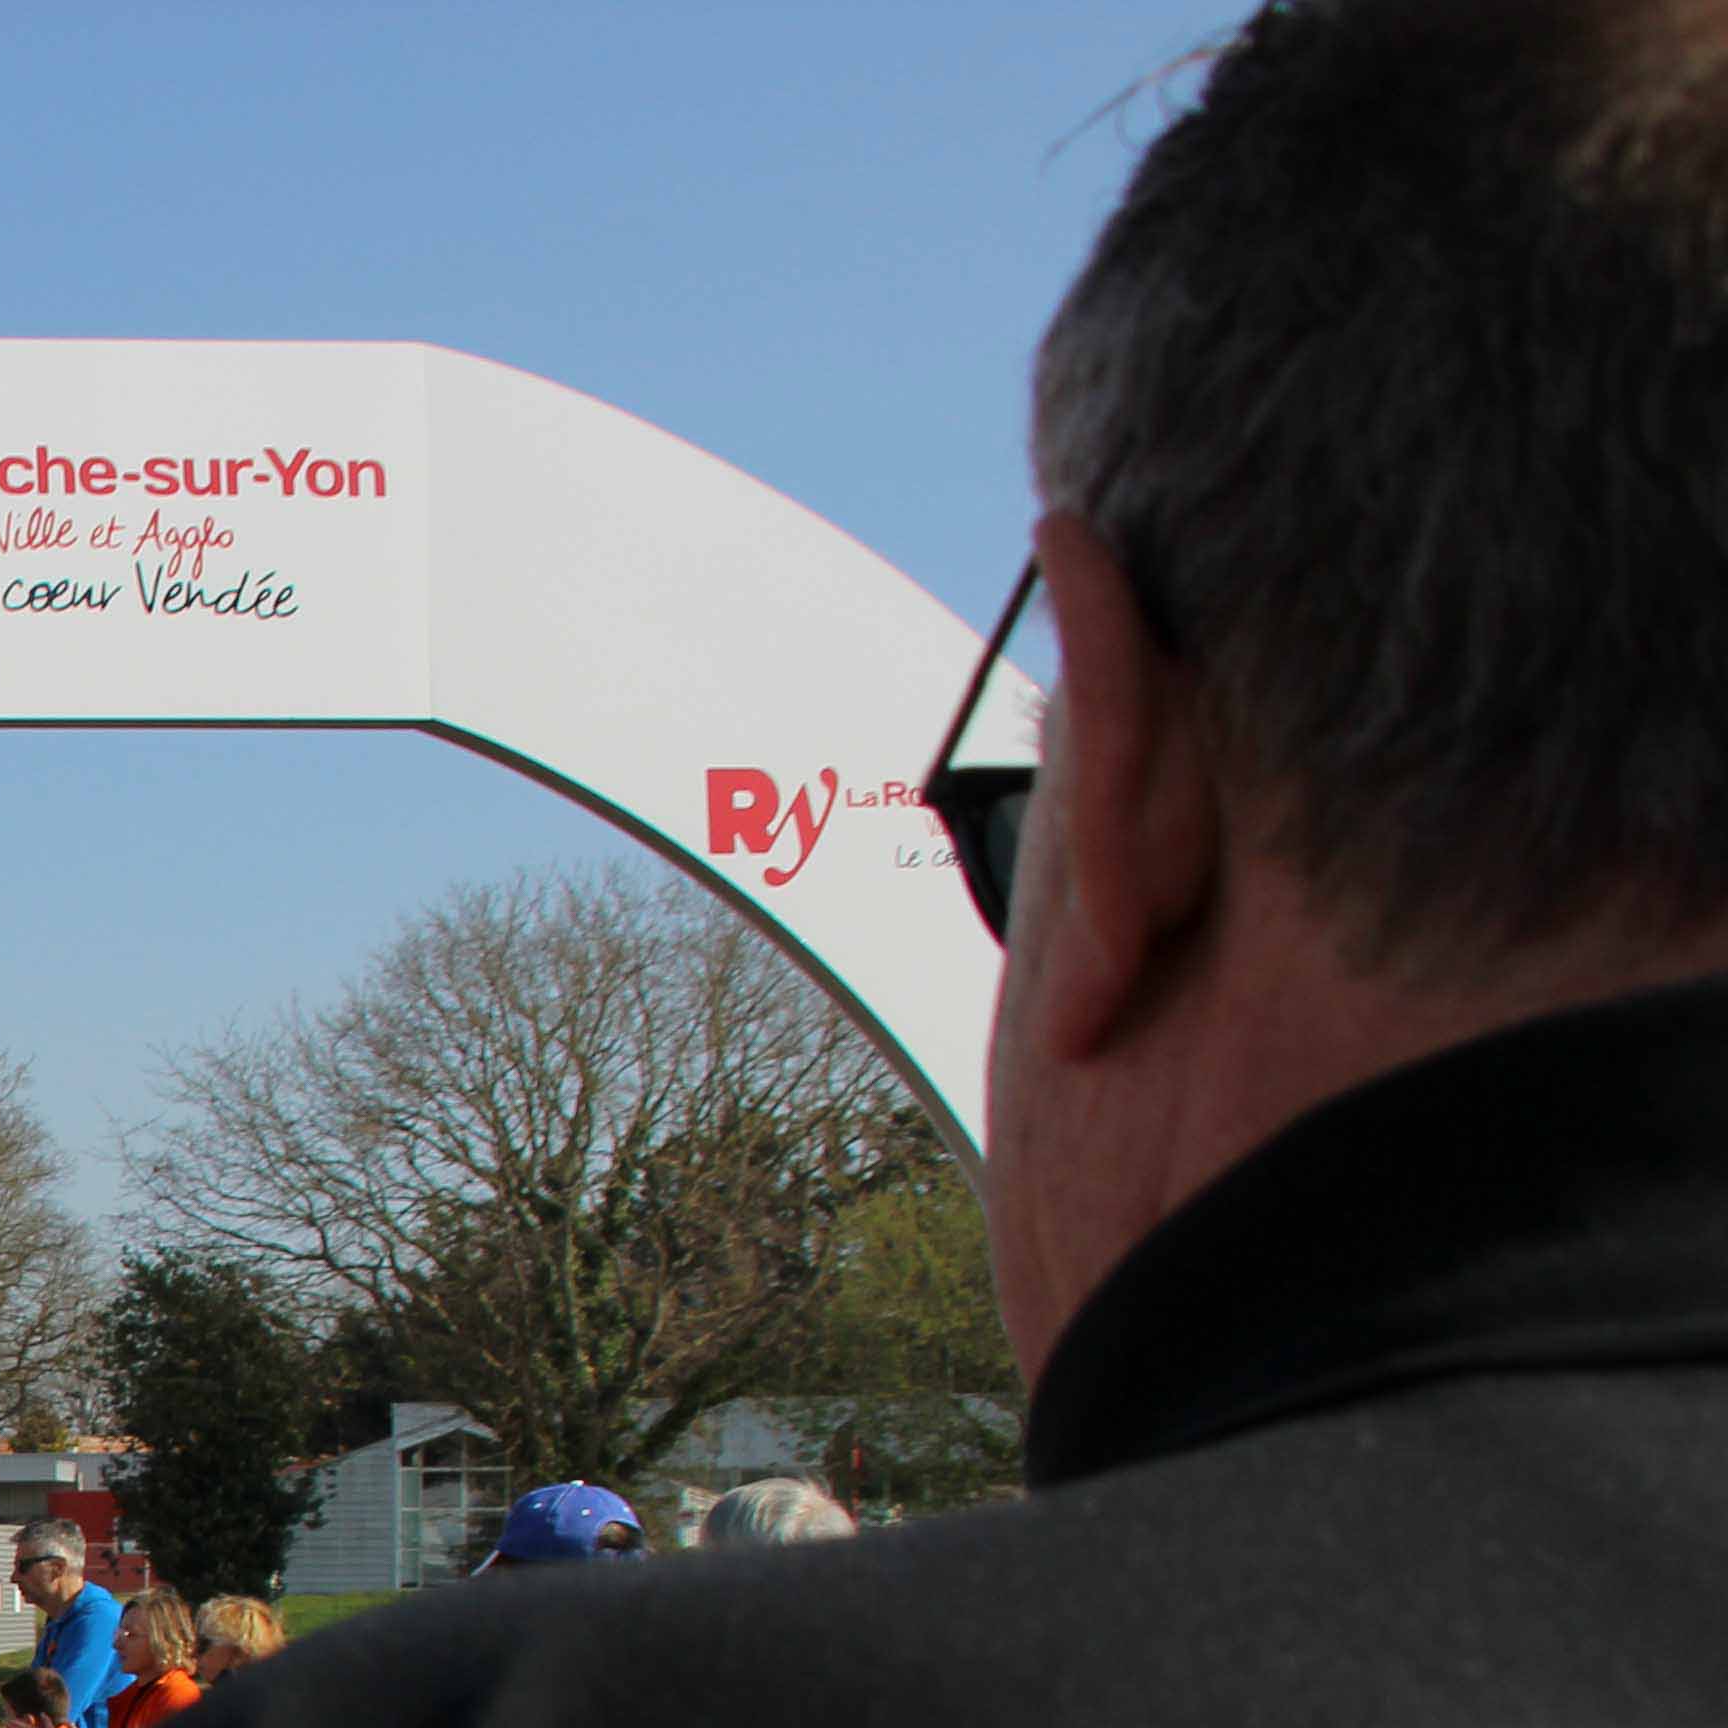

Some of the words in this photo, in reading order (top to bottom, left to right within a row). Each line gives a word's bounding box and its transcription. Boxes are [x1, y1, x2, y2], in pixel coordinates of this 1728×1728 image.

[89, 520, 123, 549] et
[133, 509, 235, 577] Agglo
[2, 579, 123, 613] cœur
[136, 561, 299, 620] Vendée
[846, 787, 878, 808] La
[896, 845, 921, 869] Le
